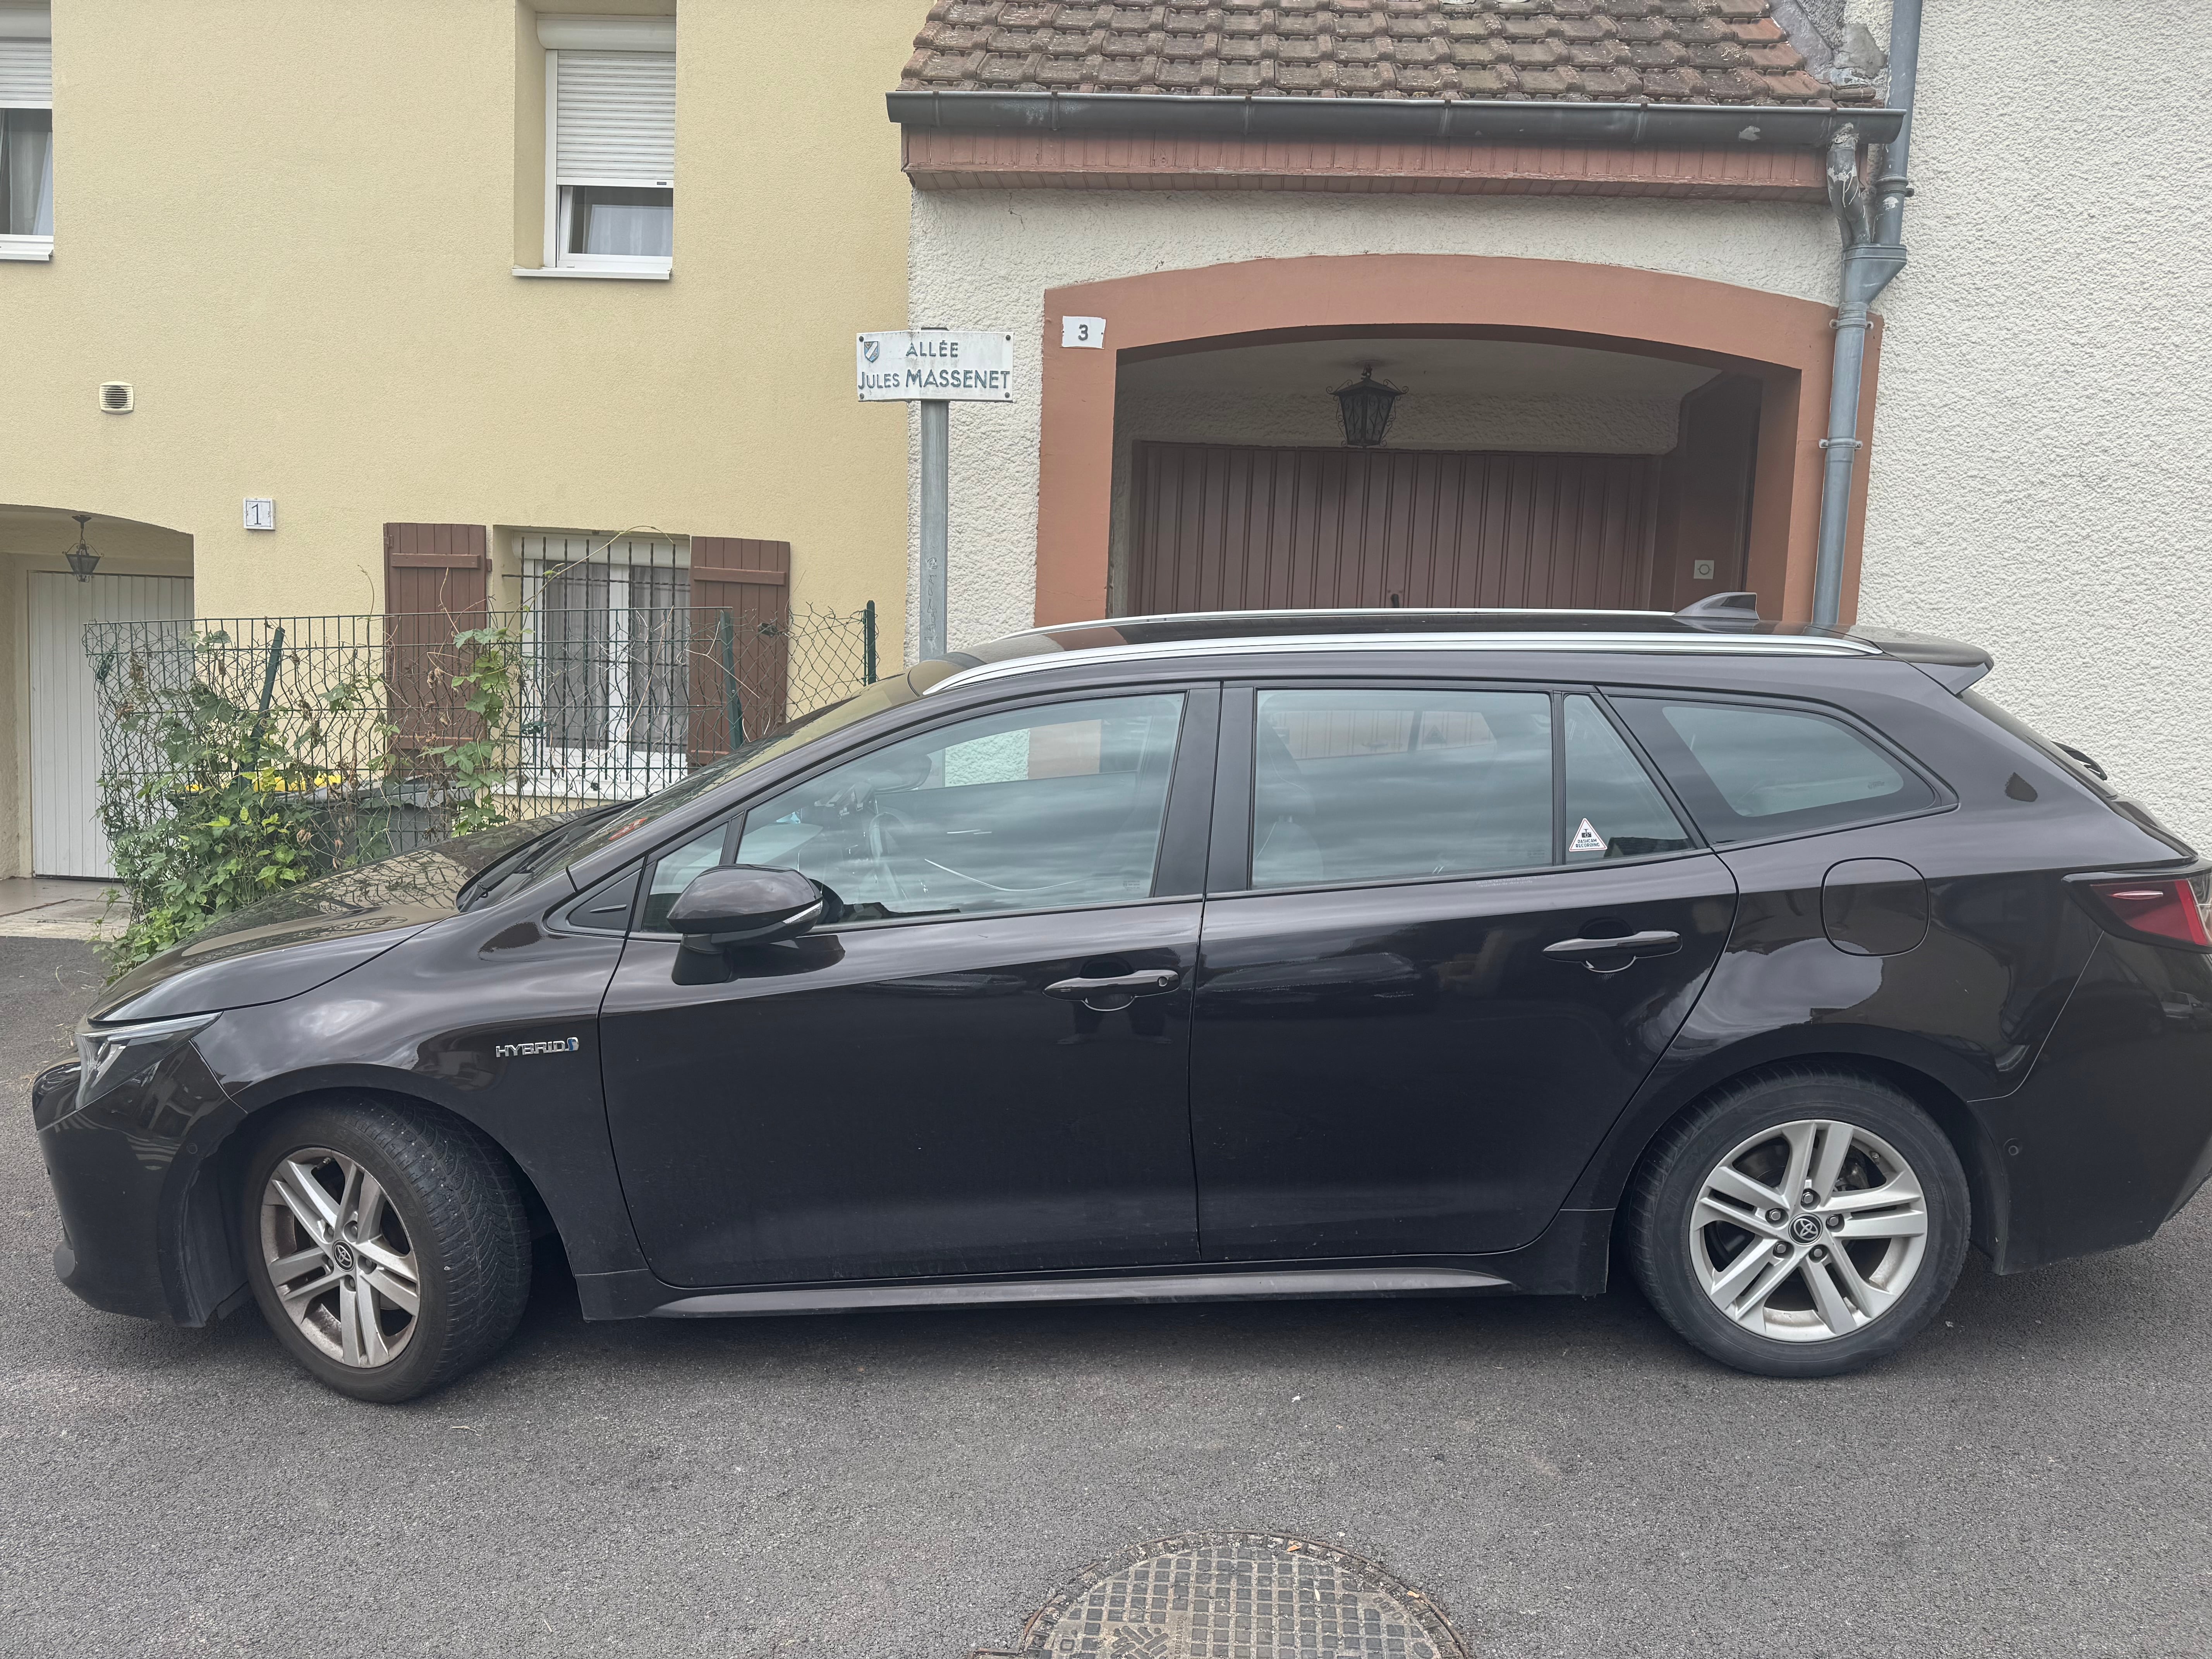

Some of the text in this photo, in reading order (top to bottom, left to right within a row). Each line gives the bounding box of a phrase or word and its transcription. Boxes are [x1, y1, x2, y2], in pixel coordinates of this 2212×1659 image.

[1078, 324, 1089, 341] 3
[905, 340, 958, 357] ALLÉE
[858, 369, 1010, 390] JULES MASSENET
[251, 503, 262, 525] 1
[495, 1040, 565, 1058] HYBRID
